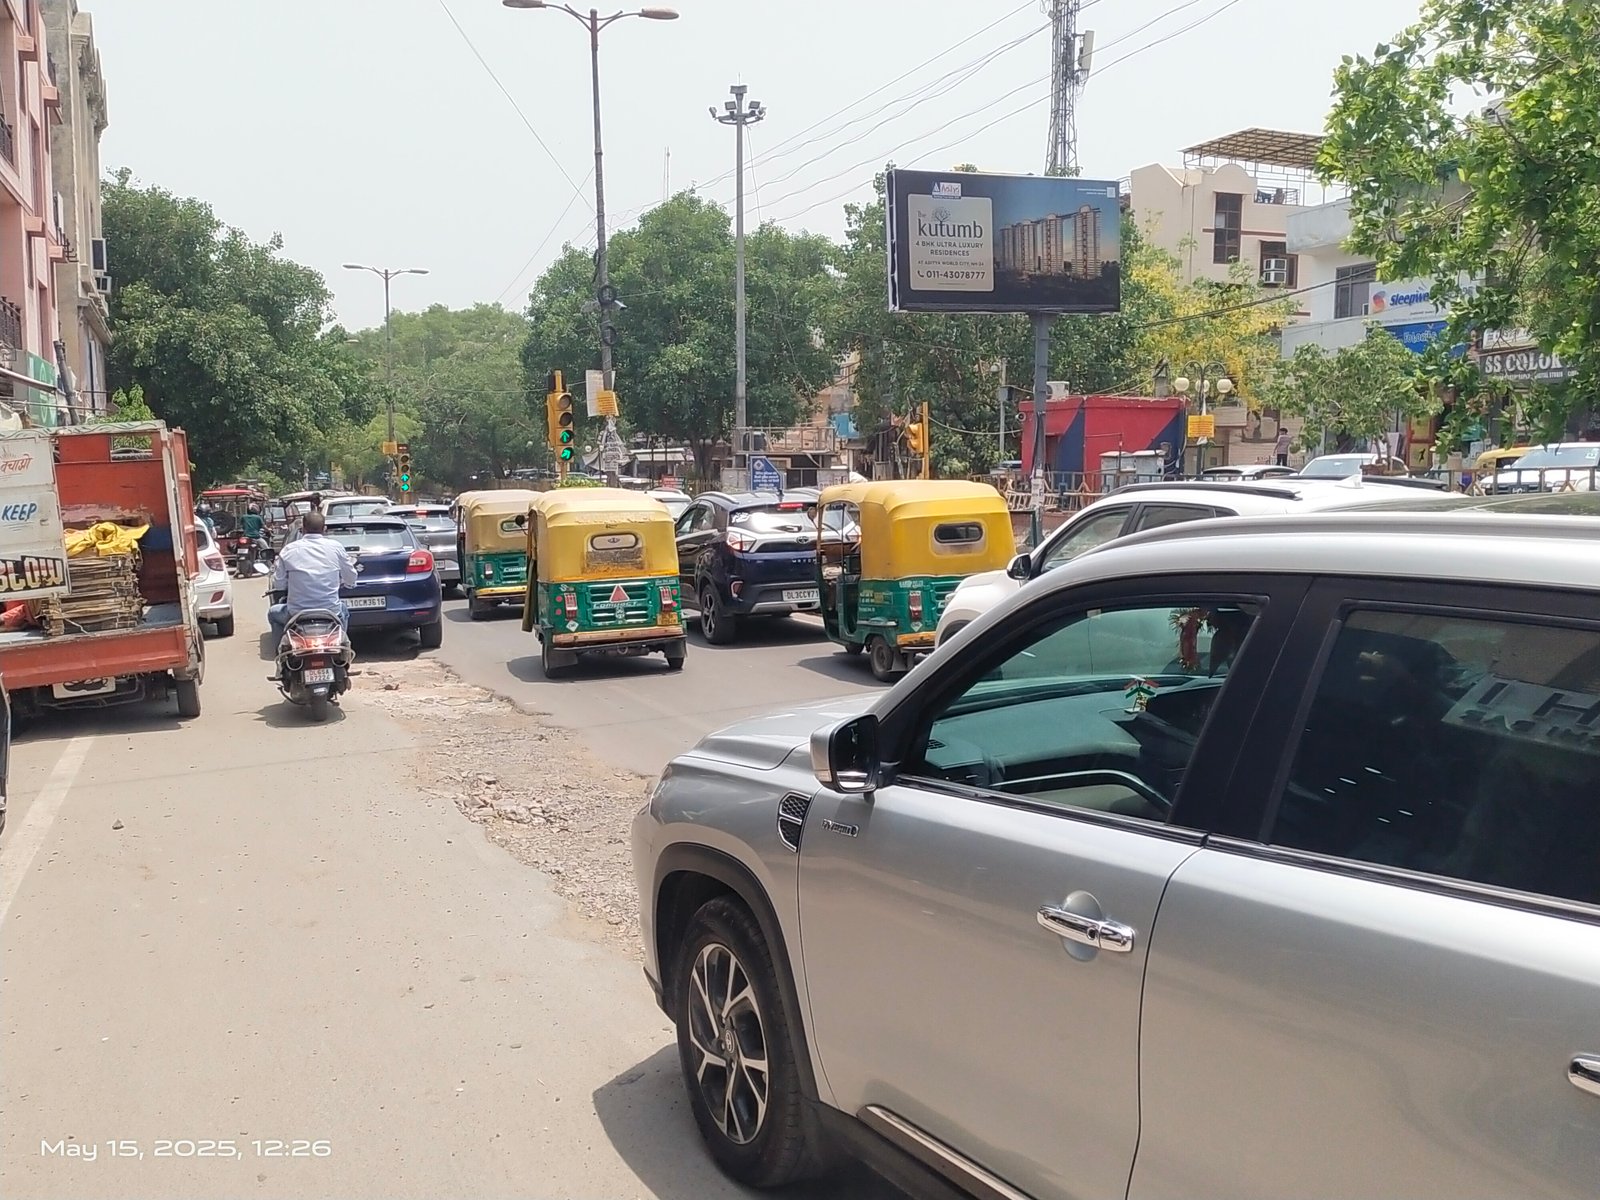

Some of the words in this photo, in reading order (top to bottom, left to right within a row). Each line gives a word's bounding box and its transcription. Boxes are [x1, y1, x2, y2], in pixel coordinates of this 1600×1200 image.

[917, 218, 983, 239] kutumb
[930, 249, 970, 257] RESIDENCES
[926, 270, 986, 280] 011-43078777
[1485, 355, 1502, 374] SS
[1, 502, 37, 521] KEEP
